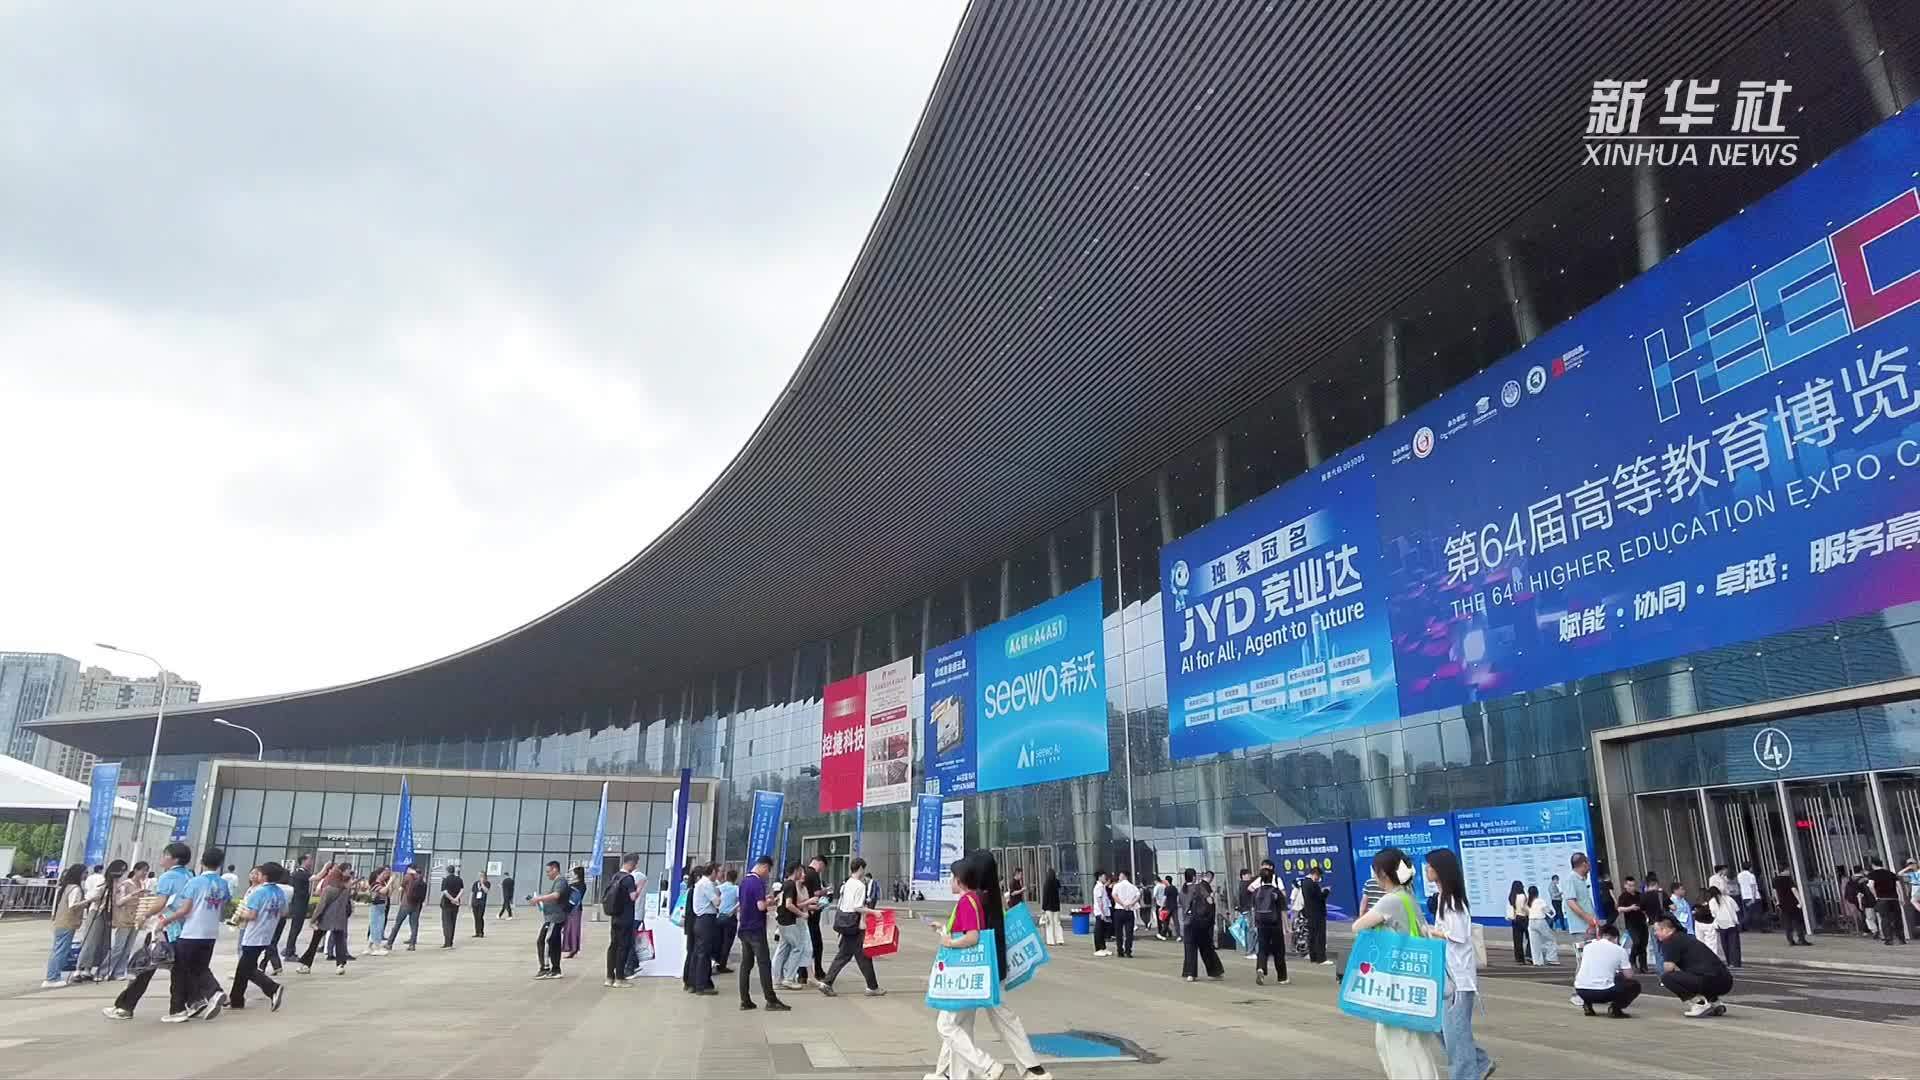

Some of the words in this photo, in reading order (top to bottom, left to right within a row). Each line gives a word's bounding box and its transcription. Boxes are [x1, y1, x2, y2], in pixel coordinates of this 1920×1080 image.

[1211, 522, 1307, 587] 独家冠名
[1451, 586, 1485, 619] THE
[1492, 574, 1526, 607] 64th
[1530, 549, 1613, 593] HIGHER
[1621, 489, 1776, 563] EDUCATION
[1788, 454, 1882, 507] EXPO
[1261, 543, 1363, 623] 竞业达
[1181, 656, 1194, 675] AI
[1196, 649, 1215, 670] for
[1244, 628, 1288, 660] Agent
[1288, 621, 1307, 641] to
[1311, 600, 1365, 636] Future
[1763, 732, 1783, 766] 4
[934, 972, 985, 990] AI+心理
[1351, 976, 1428, 1006] AI+心理
